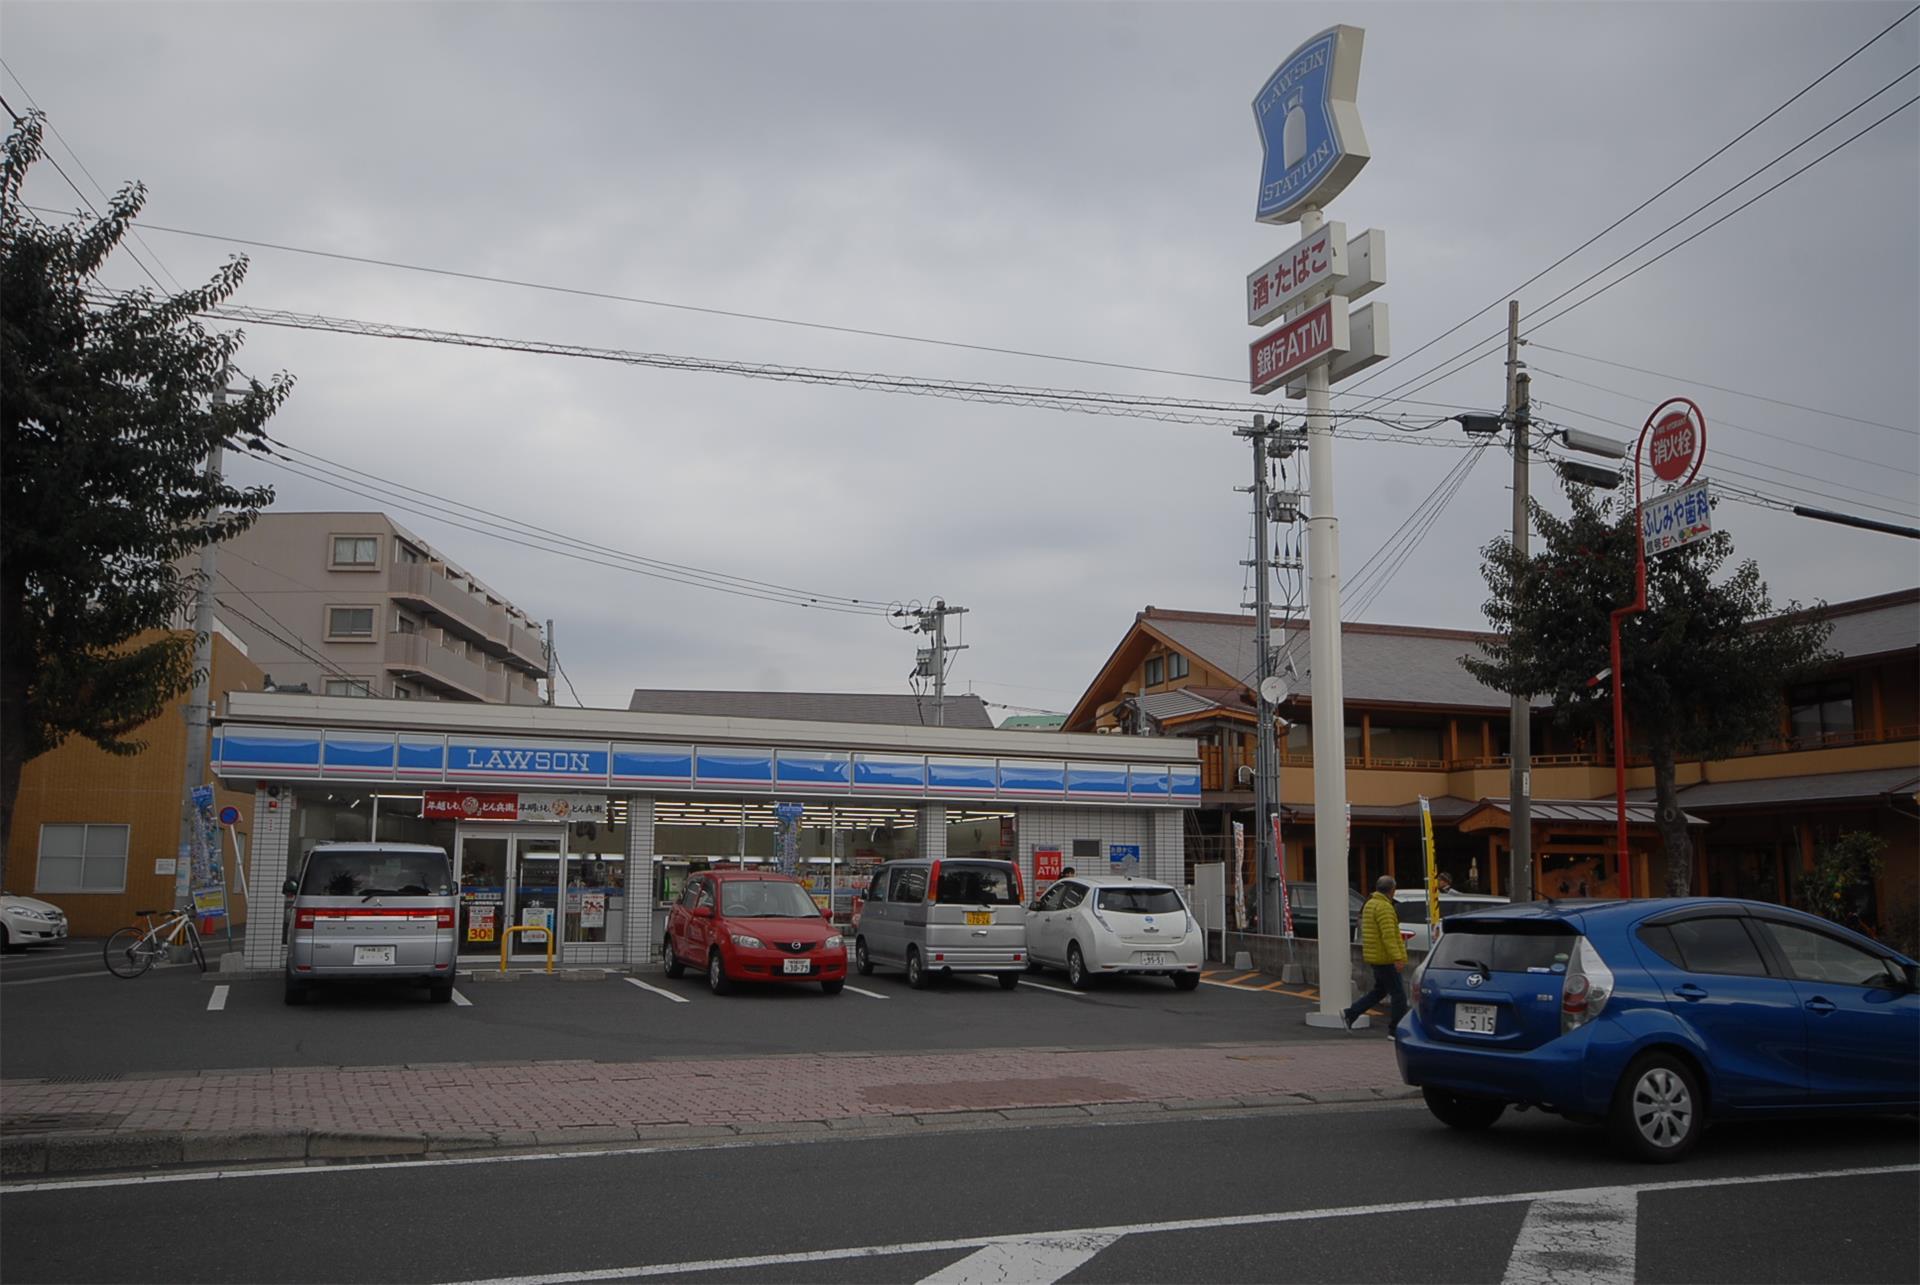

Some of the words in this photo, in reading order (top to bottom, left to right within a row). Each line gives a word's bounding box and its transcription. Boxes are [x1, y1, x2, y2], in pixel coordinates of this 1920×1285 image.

[1261, 47, 1327, 116] LAWSON
[1262, 139, 1330, 202] STATION
[1252, 239, 1328, 311] 酒・たばこ
[1256, 313, 1328, 378] 銀行ATM
[1653, 429, 1692, 466] 消火栓
[1644, 488, 1709, 537] ふじみや歯科
[466, 748, 590, 772] LAWSON
[1037, 866, 1060, 876] ATM
